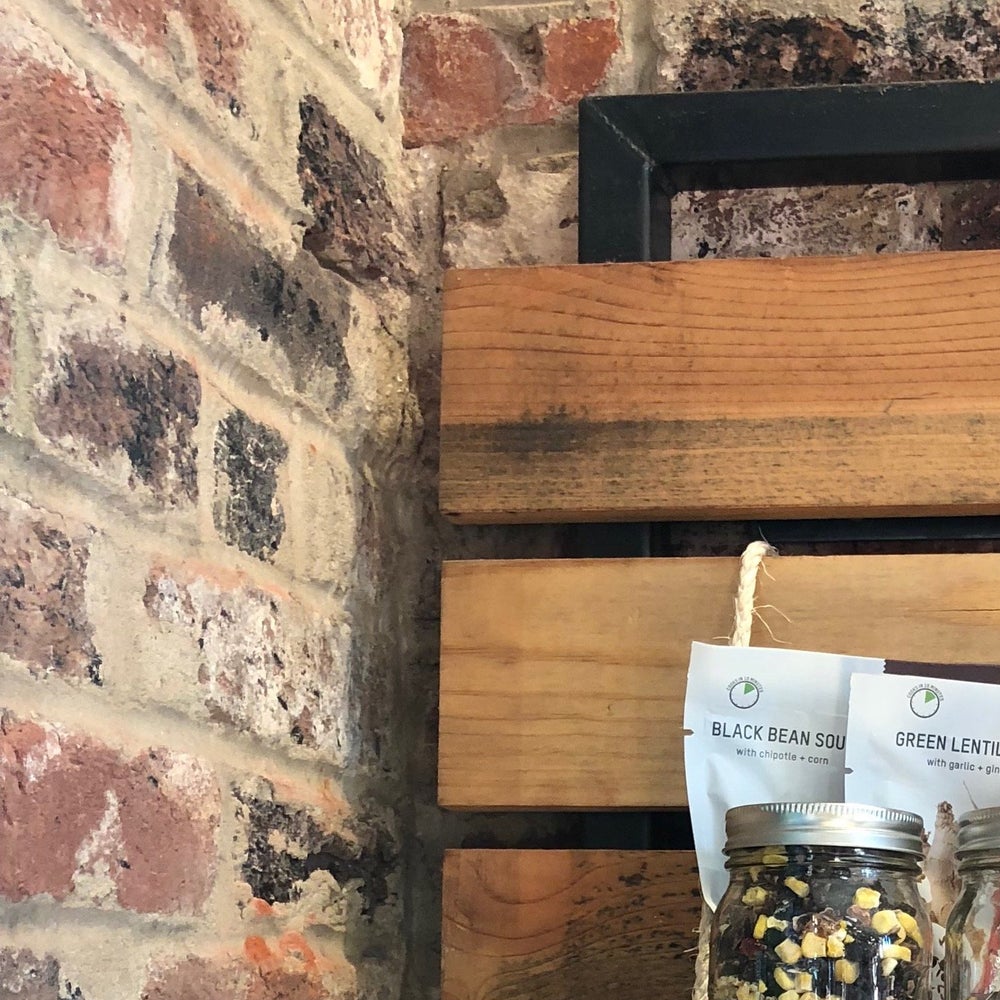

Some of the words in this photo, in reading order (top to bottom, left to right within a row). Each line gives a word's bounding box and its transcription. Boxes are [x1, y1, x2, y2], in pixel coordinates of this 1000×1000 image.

[711, 721, 763, 741] BLACK
[767, 727, 811, 745] BEAN
[895, 731, 947, 752] GREEN
[735, 747, 757, 758] with
[759, 750, 798, 764] chipotle
[806, 756, 830, 766] corn
[926, 757, 947, 769] with
[948, 760, 975, 773] garlic
